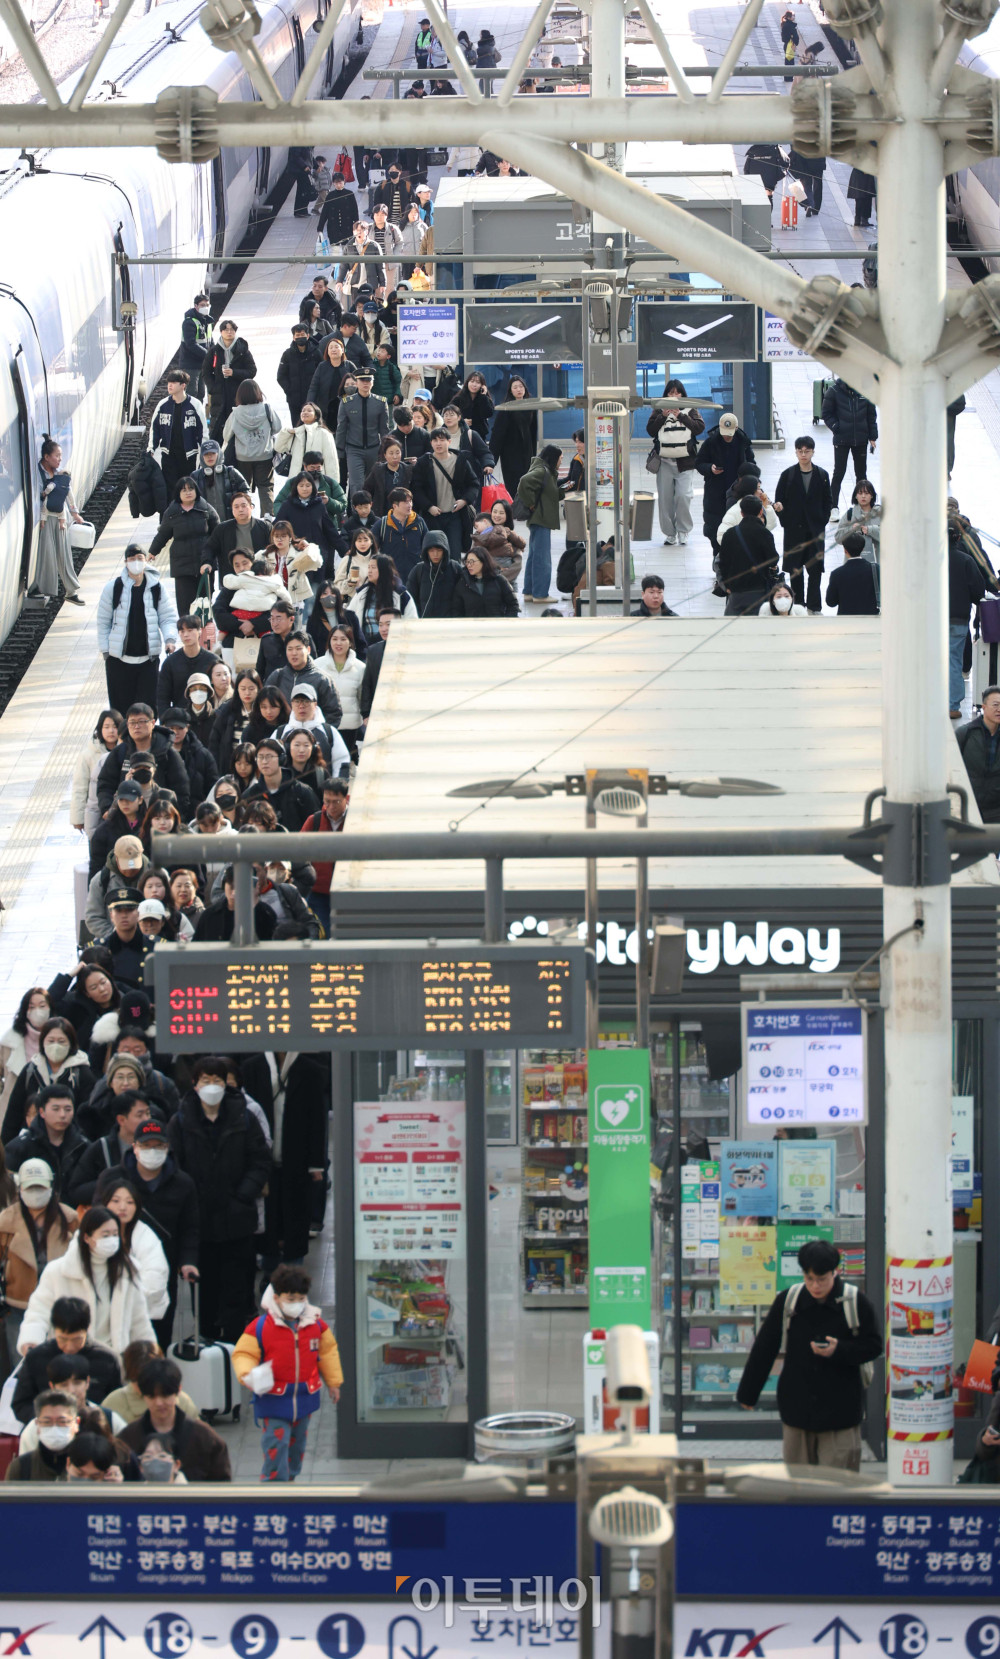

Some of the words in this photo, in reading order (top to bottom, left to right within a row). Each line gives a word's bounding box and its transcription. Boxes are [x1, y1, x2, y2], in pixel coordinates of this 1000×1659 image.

[767, 321, 785, 329] KTX
[753, 1014, 800, 1029] 호차번호
[749, 1041, 776, 1052] KTX
[749, 1085, 772, 1094] KTX
[809, 1083, 834, 1091] 무궁화
[539, 1207, 589, 1223] Story
[891, 1277, 922, 1297] 전기
[87, 1515, 121, 1534] 대전
[137, 1515, 187, 1535] 동대구
[203, 1515, 238, 1535] 부산
[253, 1515, 288, 1535] 포항
[304, 1515, 337, 1534] 진주
[353, 1515, 388, 1534] 마산
[832, 1515, 866, 1534] 대전
[882, 1515, 932, 1535] 동대구
[949, 1515, 983, 1535] 부산
[204, 1537, 235, 1546] Busan
[252, 1537, 288, 1548] Pohang
[354, 1537, 387, 1546] Masan
[949, 1537, 980, 1547] Busan
[88, 1550, 123, 1570] 익산
[137, 1551, 205, 1571] 광주송정
[220, 1551, 254, 1570] 목포
[270, 1551, 352, 1570] 여수EXPO
[358, 1551, 392, 1571] 방면
[876, 1551, 910, 1571] 익산
[926, 1552, 992, 1571] 광주송정
[146, 1619, 192, 1653] 18
[470, 1617, 578, 1647] 호차번호
[684, 1622, 791, 1658] KTX
[881, 1620, 926, 1655] 18
